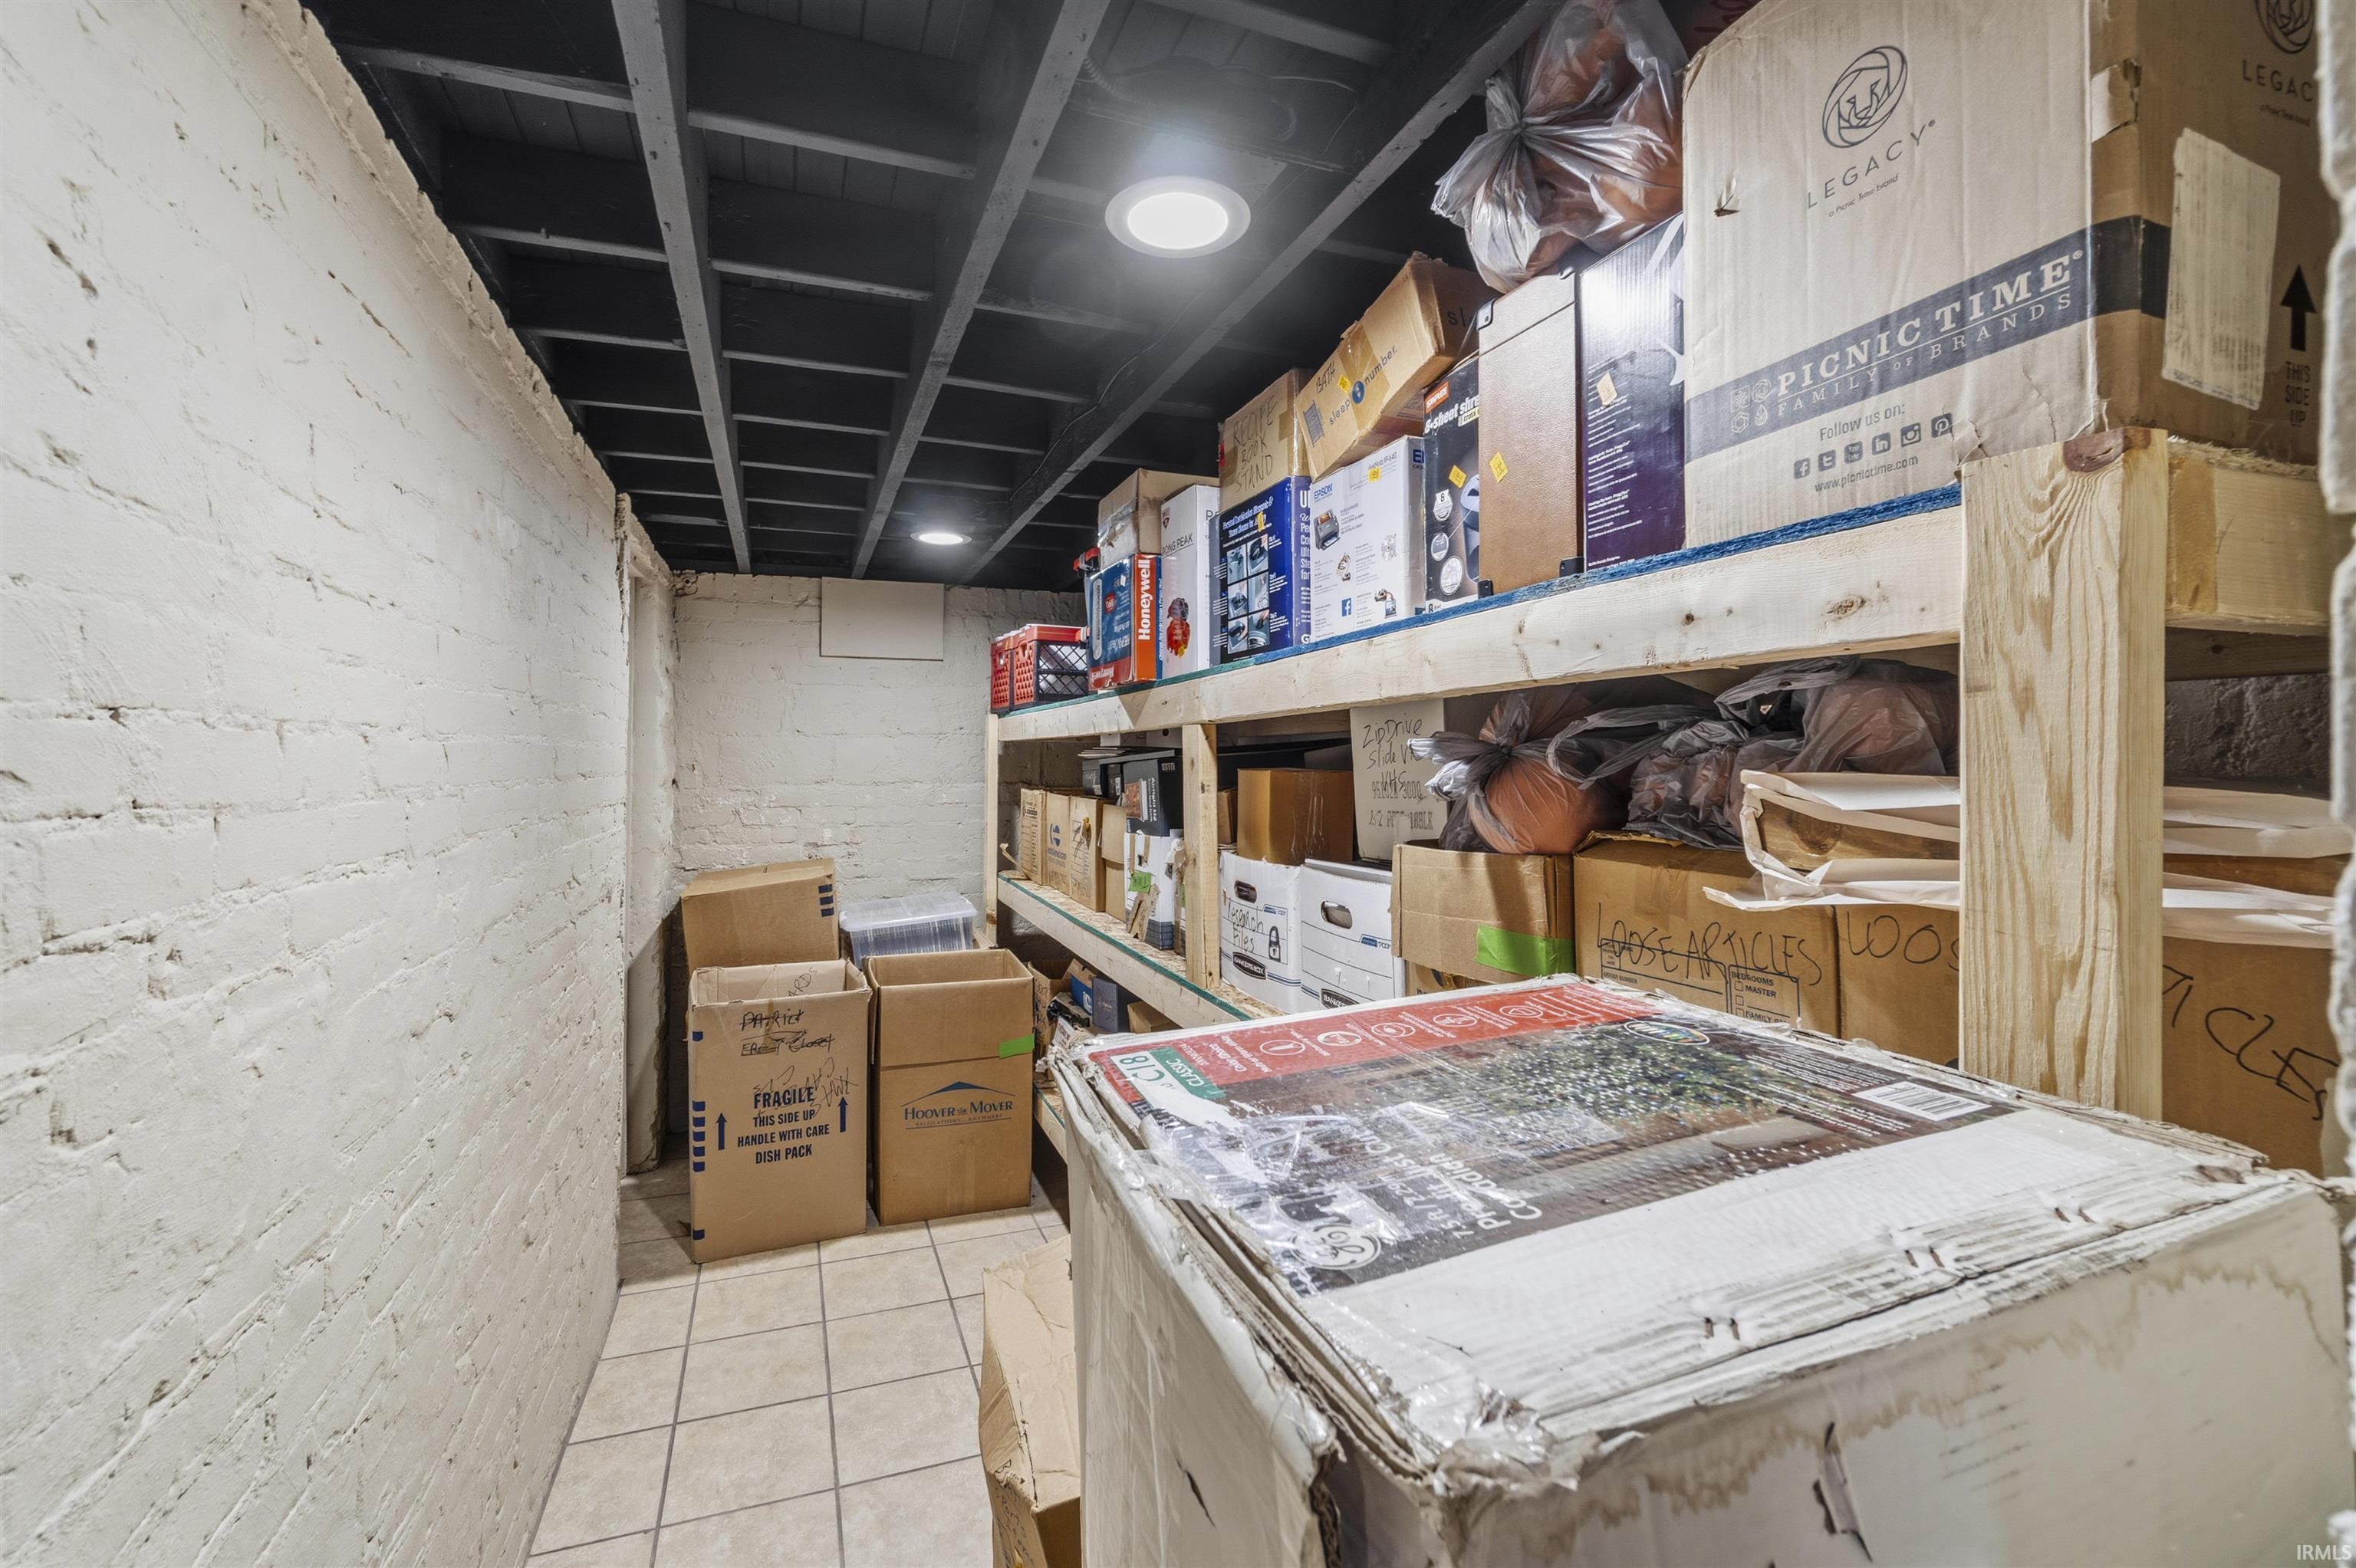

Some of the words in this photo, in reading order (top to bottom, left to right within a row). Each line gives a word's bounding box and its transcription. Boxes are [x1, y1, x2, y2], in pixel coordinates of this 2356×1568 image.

[1808, 123, 1927, 209] LEGACY
[1777, 368, 1879, 416] FAMILY
[1930, 293, 2071, 360] BRANDS
[1779, 317, 1922, 396] PICNIC
[2285, 361, 2311, 383] THIS
[2285, 385, 2310, 406] SIDE
[1329, 399, 1351, 426] sleep
[1820, 417, 1861, 442] Follow
[1865, 411, 1880, 427] us
[1884, 403, 1906, 419] on:
[1235, 455, 1273, 494] STAND
[1815, 455, 1919, 493] www.picnictime.com
[1314, 483, 1334, 500] EPSON
[1138, 559, 1153, 640] Honeywell
[1384, 718, 1423, 743] Drive
[1232, 922, 1255, 953] Files
[1598, 902, 1680, 972] LOOSE
[1686, 922, 1822, 987] ARTICLES
[1730, 971, 1775, 987] BEDROOMS
[1744, 985, 1778, 998] MASTER
[1745, 1010, 1773, 1023] FAMILY
[1165, 1058, 1205, 1086] CLASSIC
[754, 1086, 815, 1109] FRAGILE
[753, 1116, 775, 1128] THIS
[778, 1111, 800, 1126] SIDE
[803, 1109, 815, 1121] UP
[737, 1132, 776, 1148] HANDLE
[778, 1128, 803, 1142] WITH
[805, 1123, 830, 1138] CARE
[755, 1152, 781, 1165] DISH
[785, 1144, 813, 1160] PACK
[1428, 1152, 1544, 1220] Caadian
[1440, 1218, 1475, 1239] 7.5
